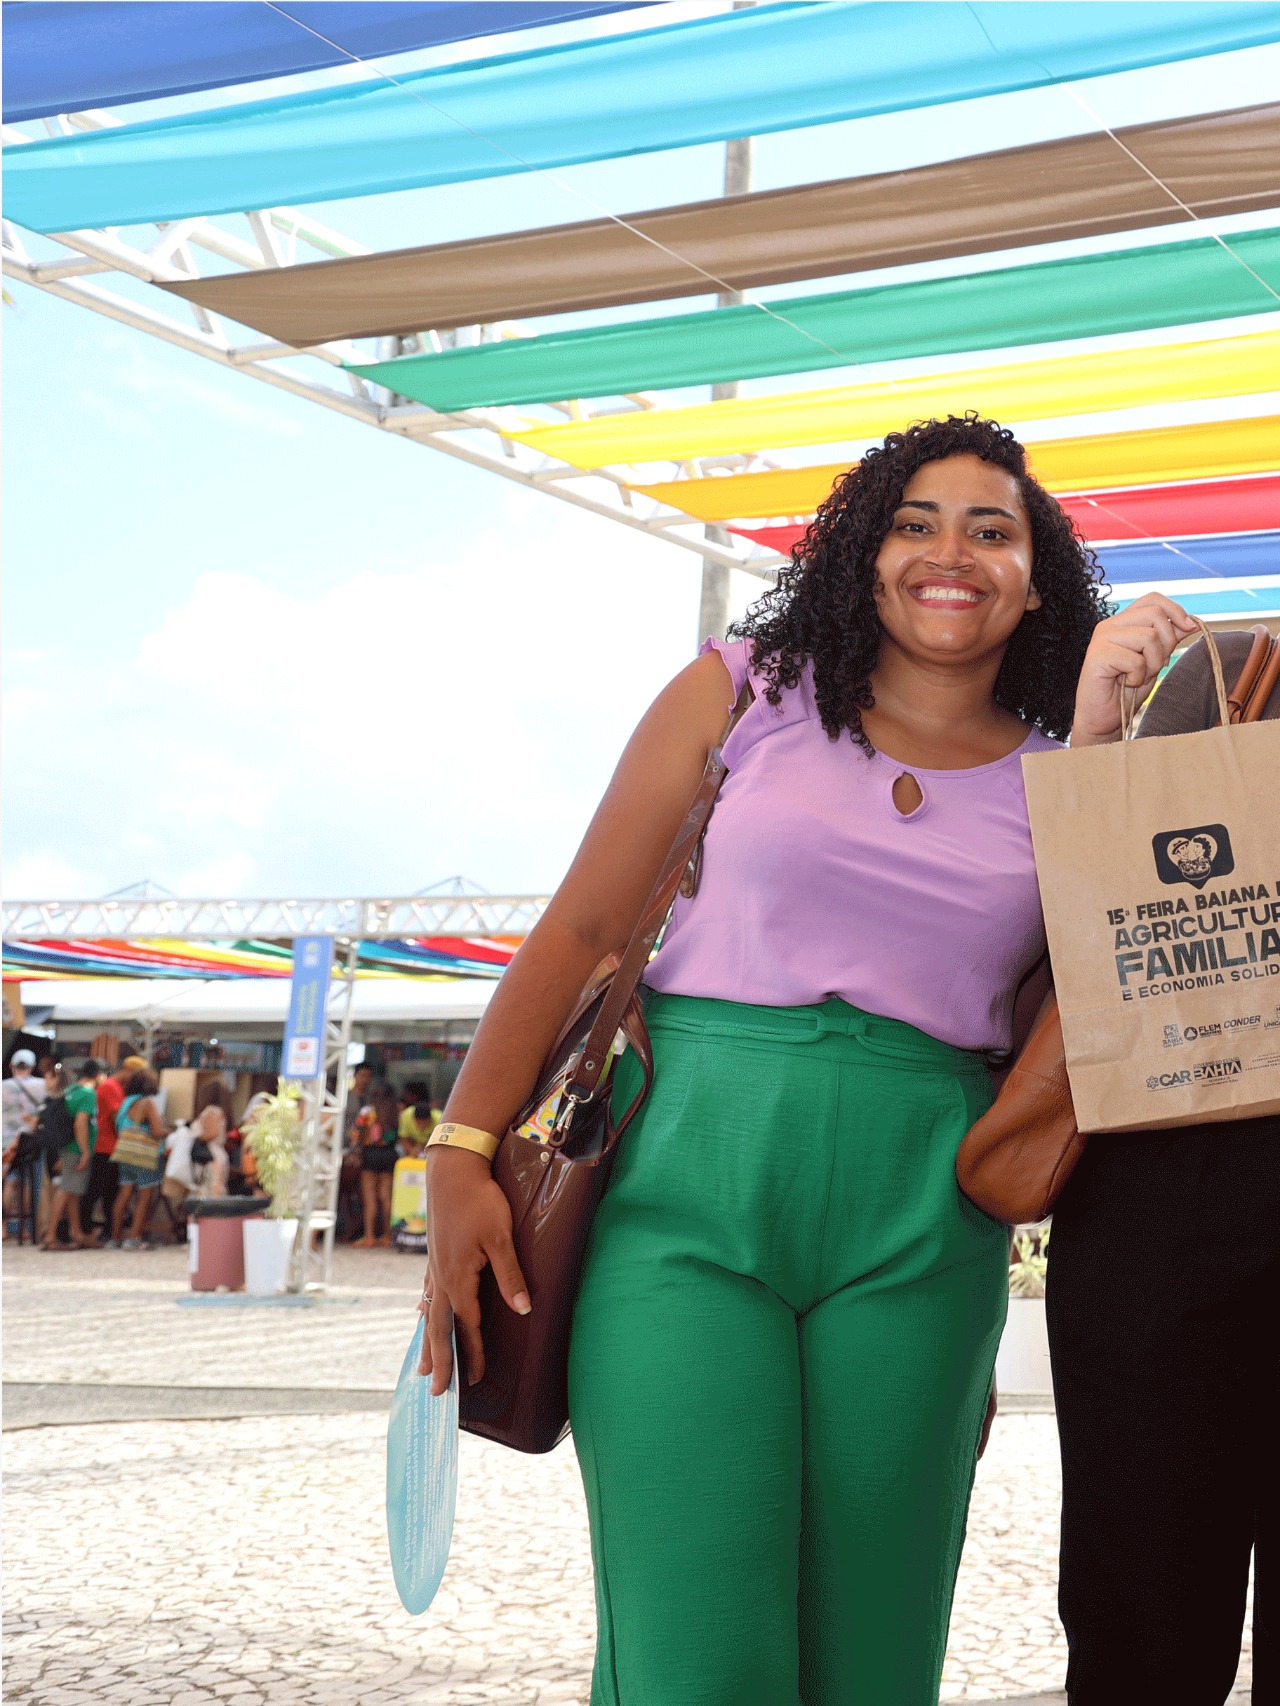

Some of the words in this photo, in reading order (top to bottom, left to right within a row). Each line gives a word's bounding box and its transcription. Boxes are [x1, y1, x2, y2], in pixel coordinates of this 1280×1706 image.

[1136, 898, 1189, 920] FEIRA
[1195, 884, 1270, 911] BAIANA
[1122, 989, 1133, 1001] E
[1139, 974, 1225, 998] ECONOMIA
[1198, 1023, 1221, 1033] FLEM
[1223, 1015, 1261, 1029] CONDER
[1159, 1070, 1192, 1086] CAR
[1194, 1060, 1242, 1080] BAHIA
